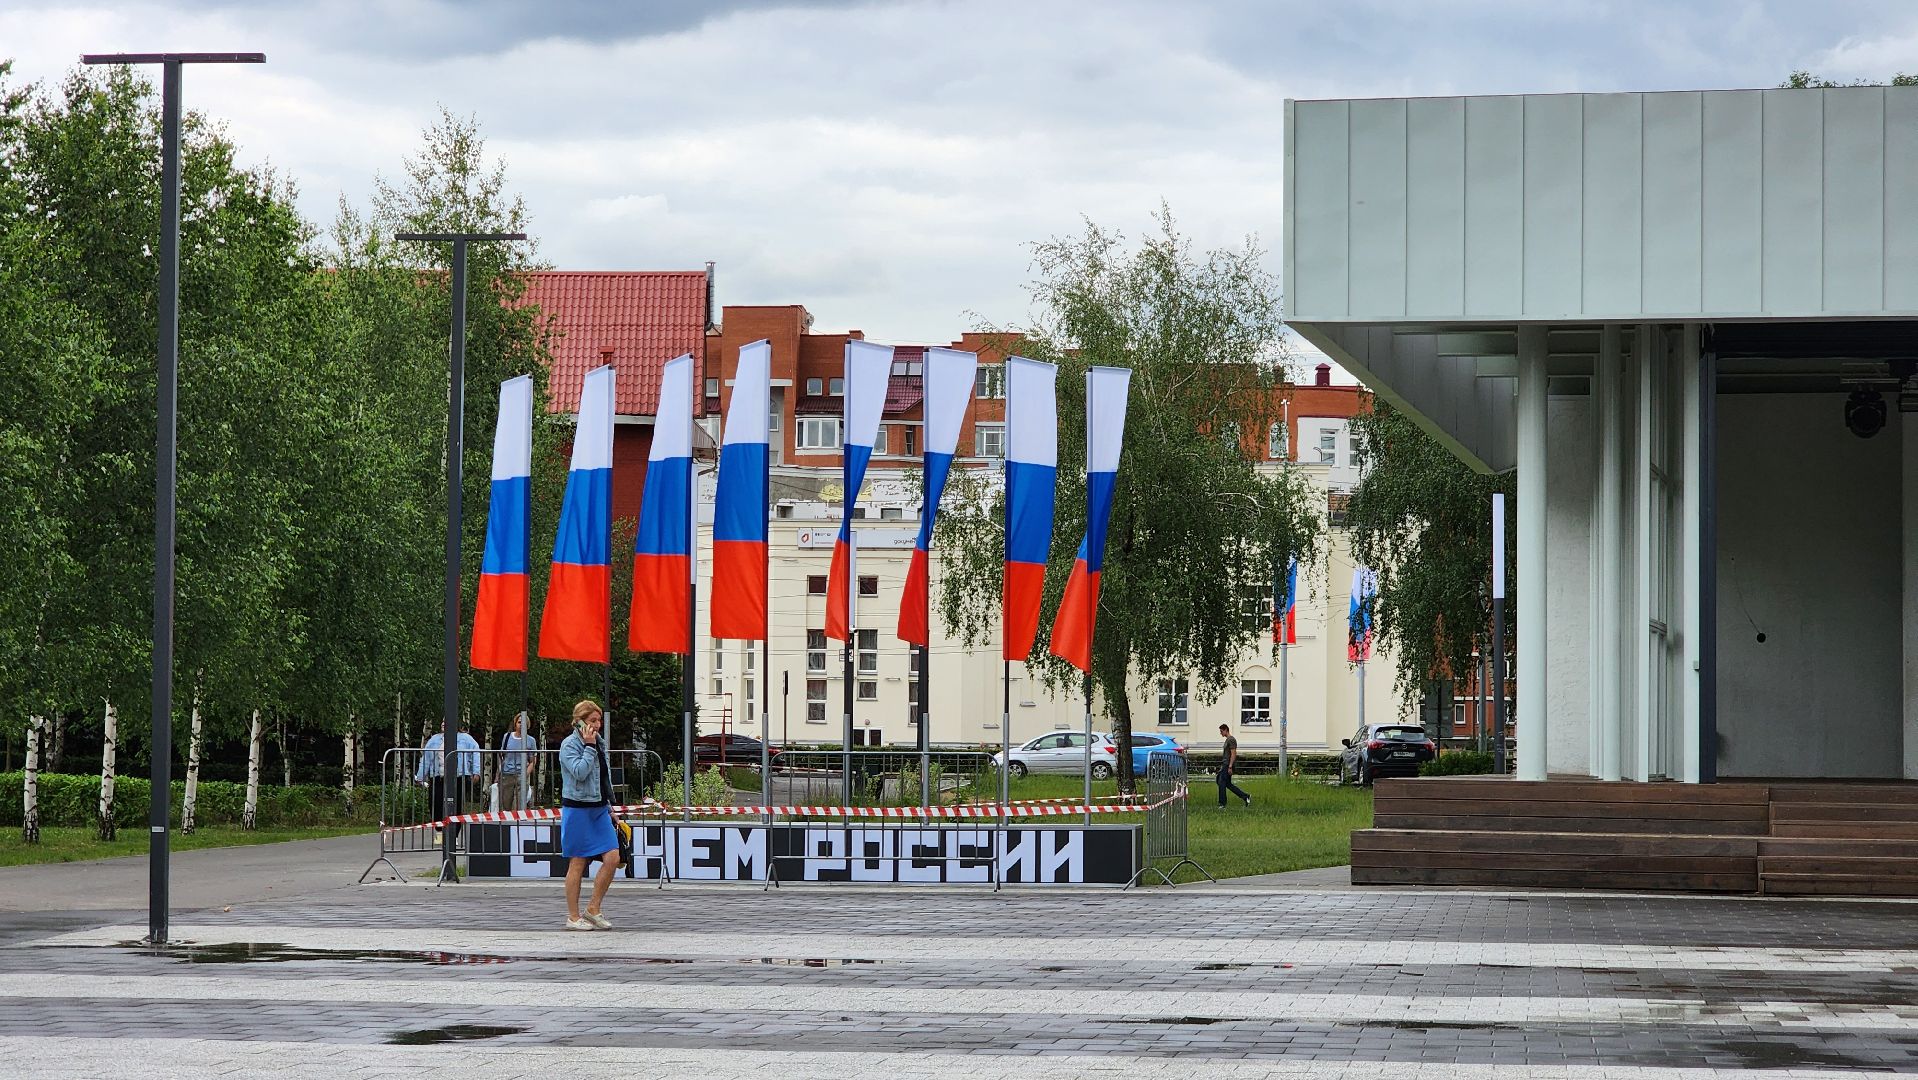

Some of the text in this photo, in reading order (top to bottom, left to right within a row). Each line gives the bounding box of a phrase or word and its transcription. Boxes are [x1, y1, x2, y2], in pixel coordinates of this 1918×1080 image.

[509, 826, 1084, 882] С НЕМ РОССИИ
